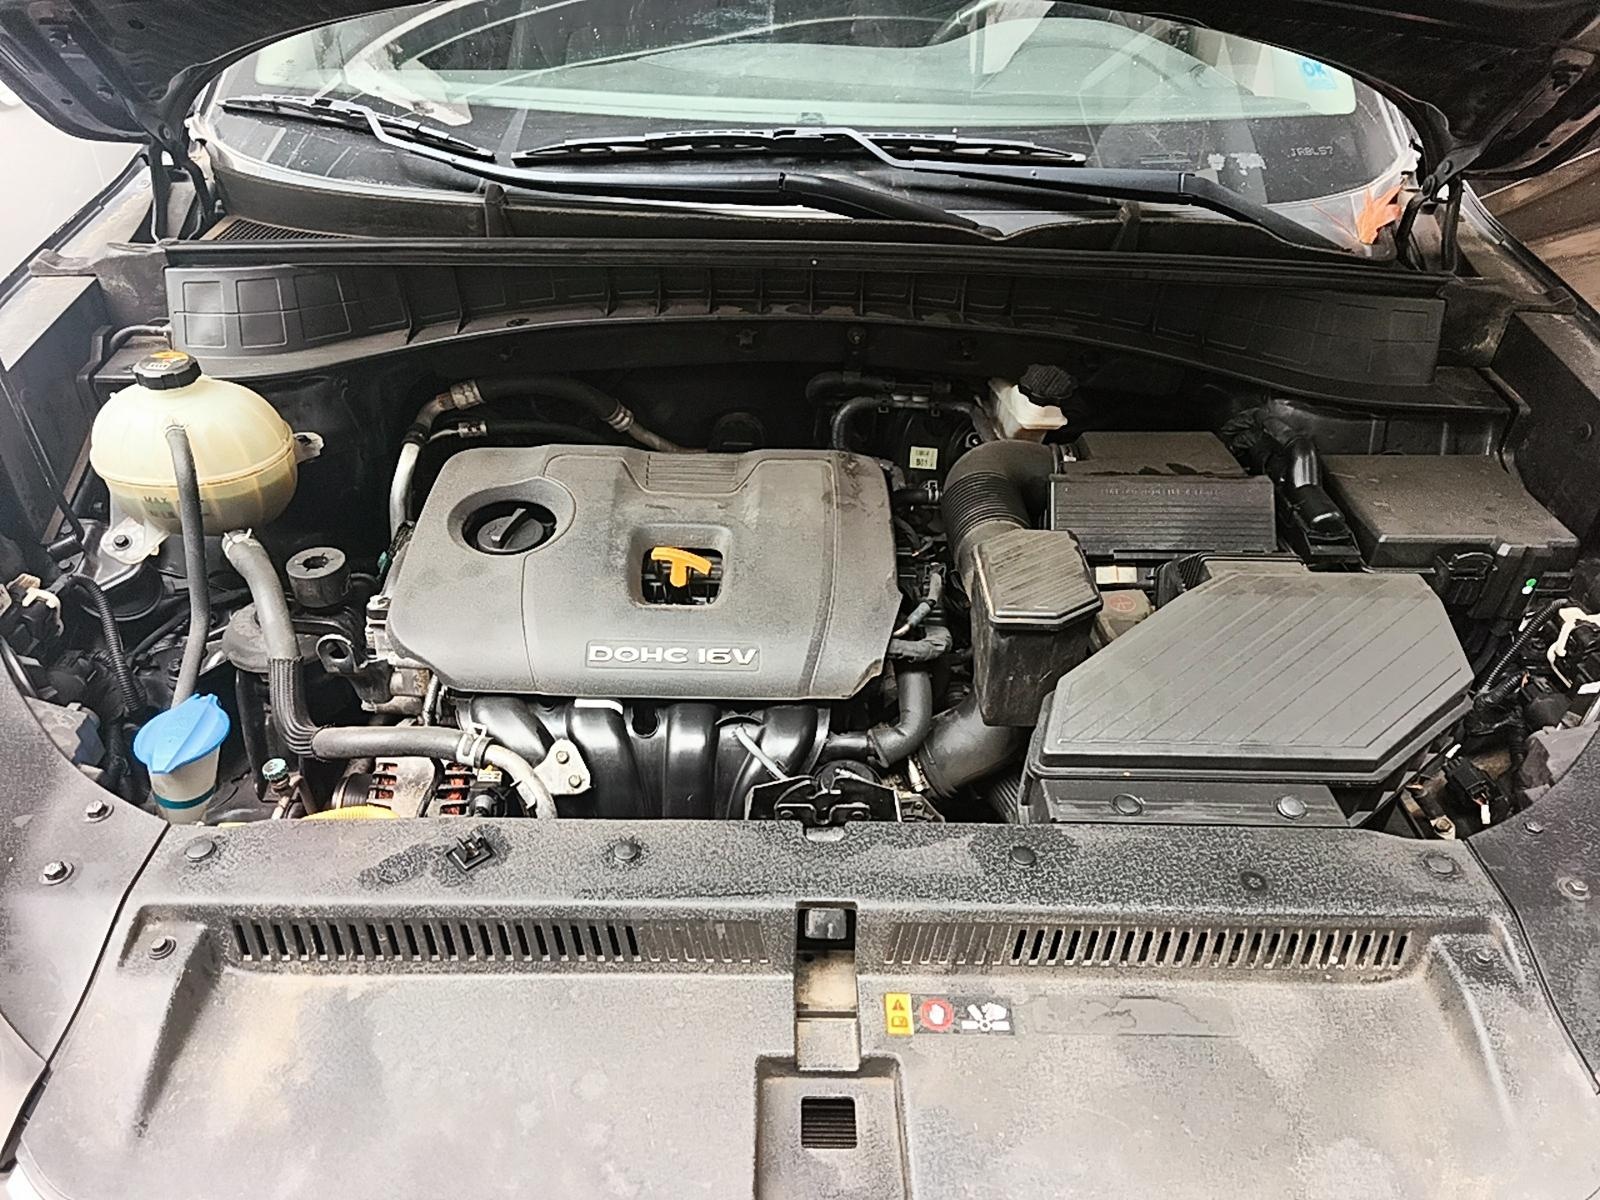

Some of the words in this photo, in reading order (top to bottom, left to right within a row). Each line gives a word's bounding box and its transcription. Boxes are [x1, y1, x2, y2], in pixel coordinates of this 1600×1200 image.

[1302, 61, 1327, 77] OK
[588, 645, 689, 663] DOHC
[698, 647, 758, 665] 16V
